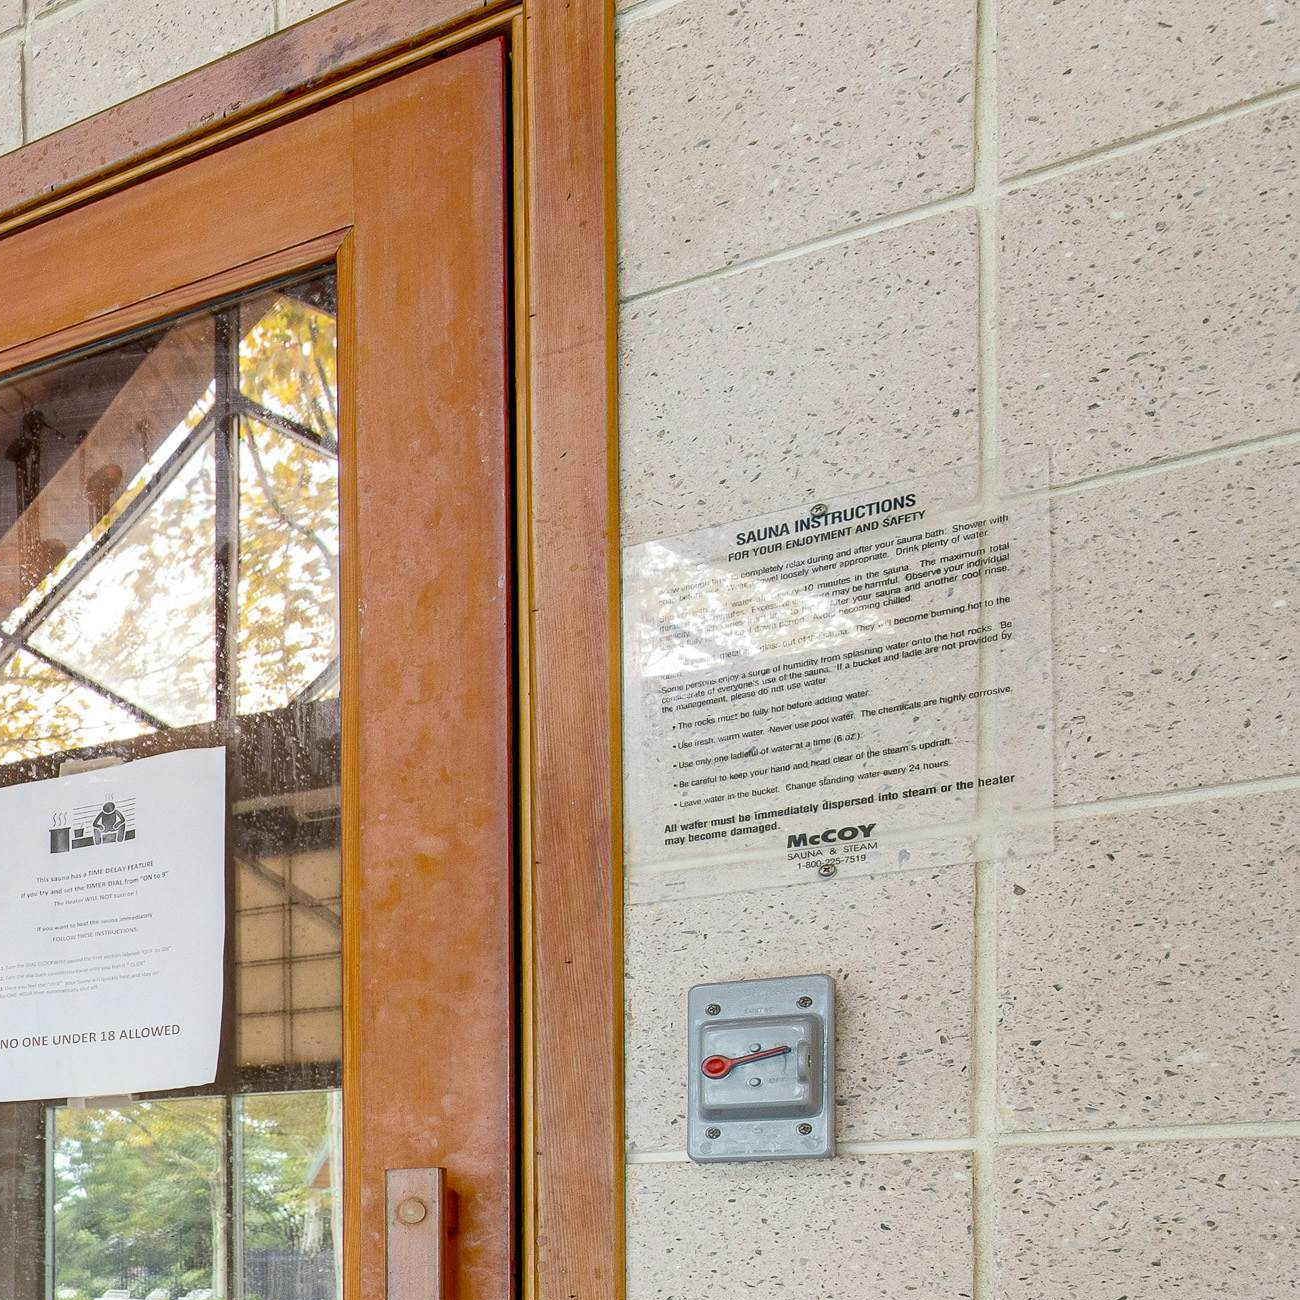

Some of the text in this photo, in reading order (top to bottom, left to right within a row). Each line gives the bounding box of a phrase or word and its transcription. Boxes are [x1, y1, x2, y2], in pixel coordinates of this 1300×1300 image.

[728, 509, 926, 562] FOR YOUR ENJOYMENT AND SAFETY
[736, 492, 916, 546] SAUNA INSTRUCTIONS
[740, 563, 783, 578] completely
[785, 559, 805, 568] relax
[806, 553, 833, 564] during
[835, 547, 851, 558] and
[853, 544, 871, 554] after
[874, 540, 893, 551] your
[896, 533, 922, 545] sauna
[951, 520, 986, 533] Shower
[989, 513, 1008, 525] with
[677, 721, 692, 729] The
[694, 717, 715, 726] rocks
[717, 712, 738, 722] must
[739, 710, 750, 718] be
[751, 707, 768, 716] fully
[771, 703, 784, 713] hot
[786, 700, 812, 710] before
[814, 695, 842, 705] adding
[677, 741, 692, 749] Use
[717, 733, 739, 742] warm
[768, 724, 792, 733] Never
[794, 721, 809, 729] use
[810, 716, 829, 728] pool
[860, 709, 876, 717] The
[878, 701, 921, 714] chemicals
[923, 699, 937, 707] are
[939, 693, 966, 704] highly
[678, 780, 689, 788] Be
[690, 775, 716, 786] careful
[718, 774, 727, 782] to
[729, 772, 748, 780] keep
[750, 768, 768, 778] your
[770, 763, 790, 773] hand
[792, 760, 808, 770] and
[810, 757, 830, 767] head
[832, 755, 852, 763] clear
[855, 751, 864, 760] of
[866, 750, 879, 758] the
[918, 737, 953, 751] updraft.
[663, 774, 1015, 833] All water must be immediately dispersed into steam or the heater
[679, 760, 951, 807] Leave water in the bucket. Change standing water every 24 hours.
[664, 821, 781, 845] may become damaged.
[786, 822, 877, 849] McCOY
[786, 841, 878, 861] SAUNA & STEAM
[36, 875, 48, 884] This
[88, 868, 103, 876] TIME
[104, 865, 125, 874] DELAY
[127, 860, 153, 870] FEATURE
[797, 853, 866, 870] 1-800-225-7519
[0, 1023, 180, 1050] NO ONE UNDER 18 ALLOWED
